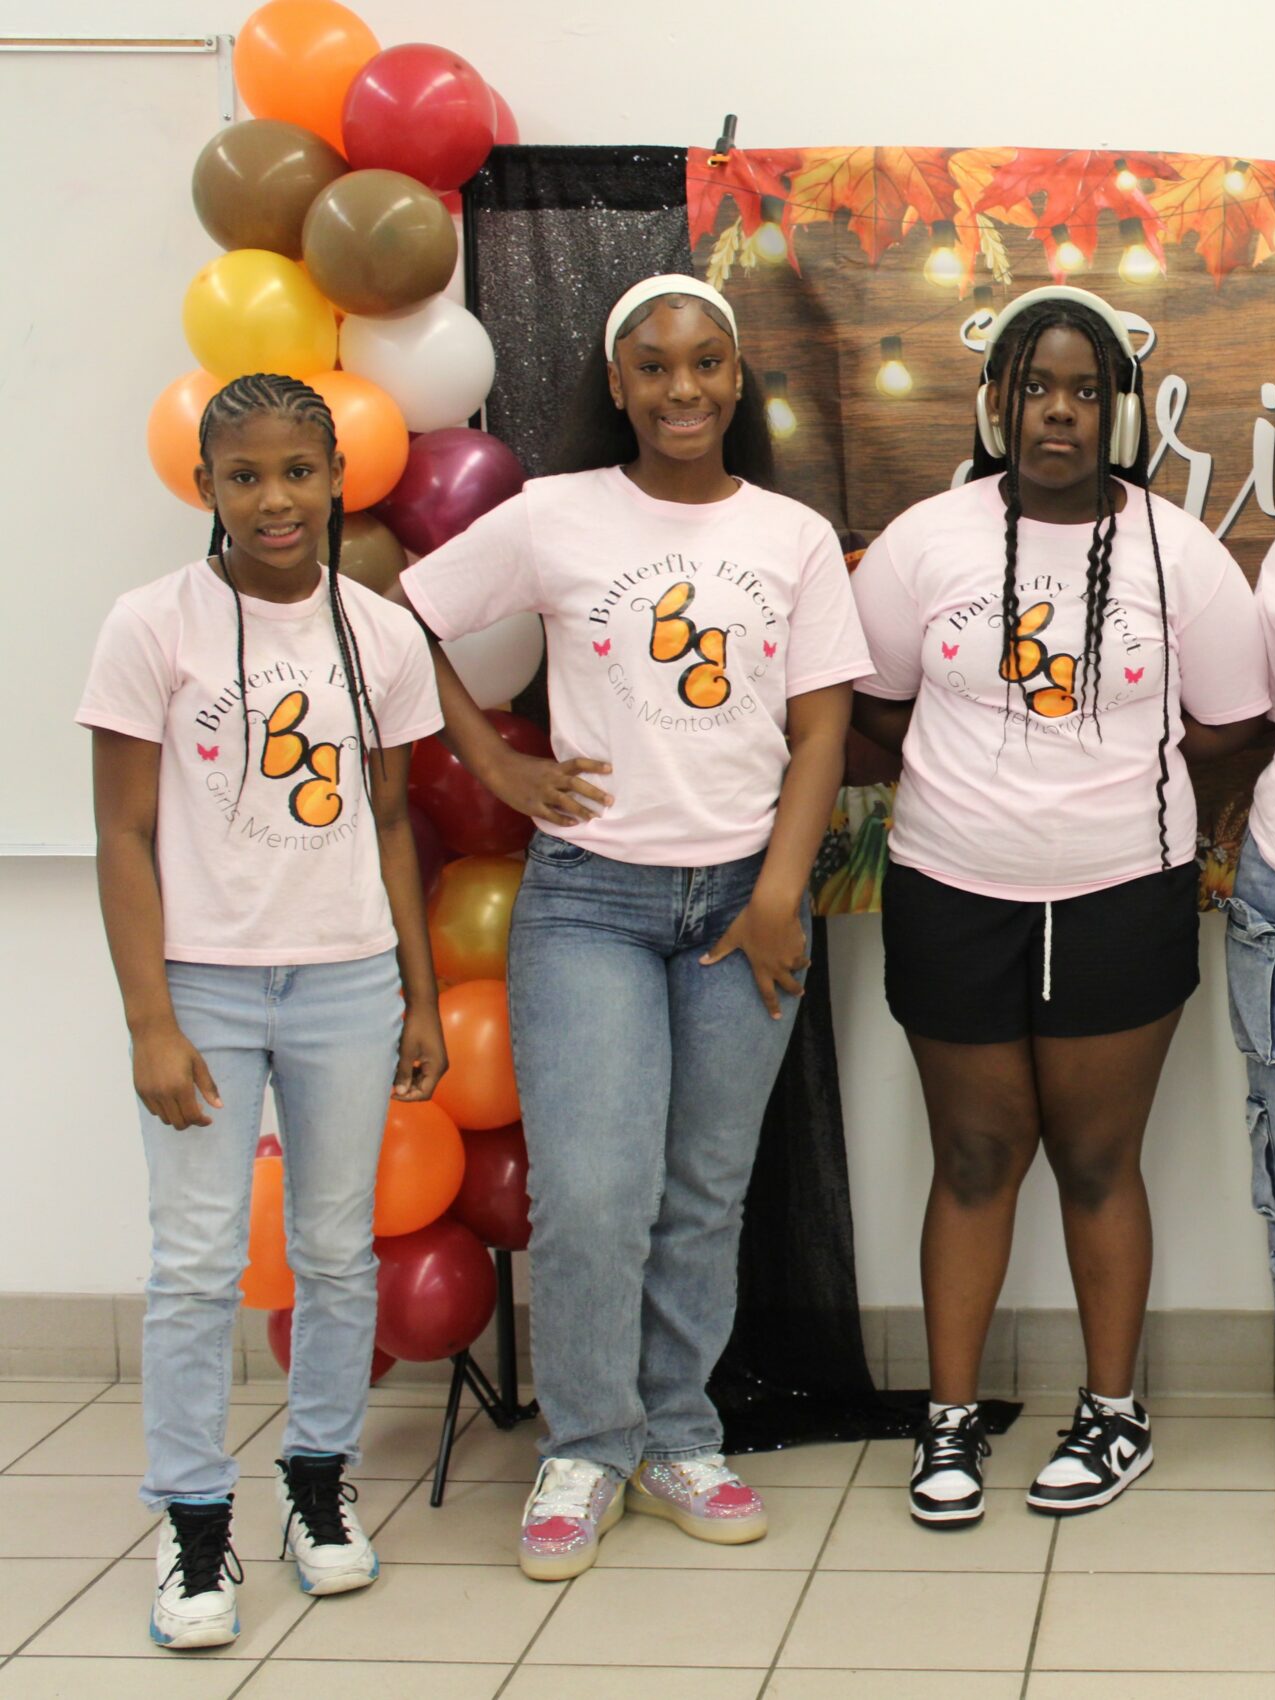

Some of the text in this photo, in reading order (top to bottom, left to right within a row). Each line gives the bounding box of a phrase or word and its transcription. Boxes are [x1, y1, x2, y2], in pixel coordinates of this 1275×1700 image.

[588, 553, 778, 630] Butterfly Effect
[947, 574, 1142, 657] Buttrfly fect
[607, 663, 770, 733] Girls Mentoring nc.
[205, 771, 241, 823] Girls
